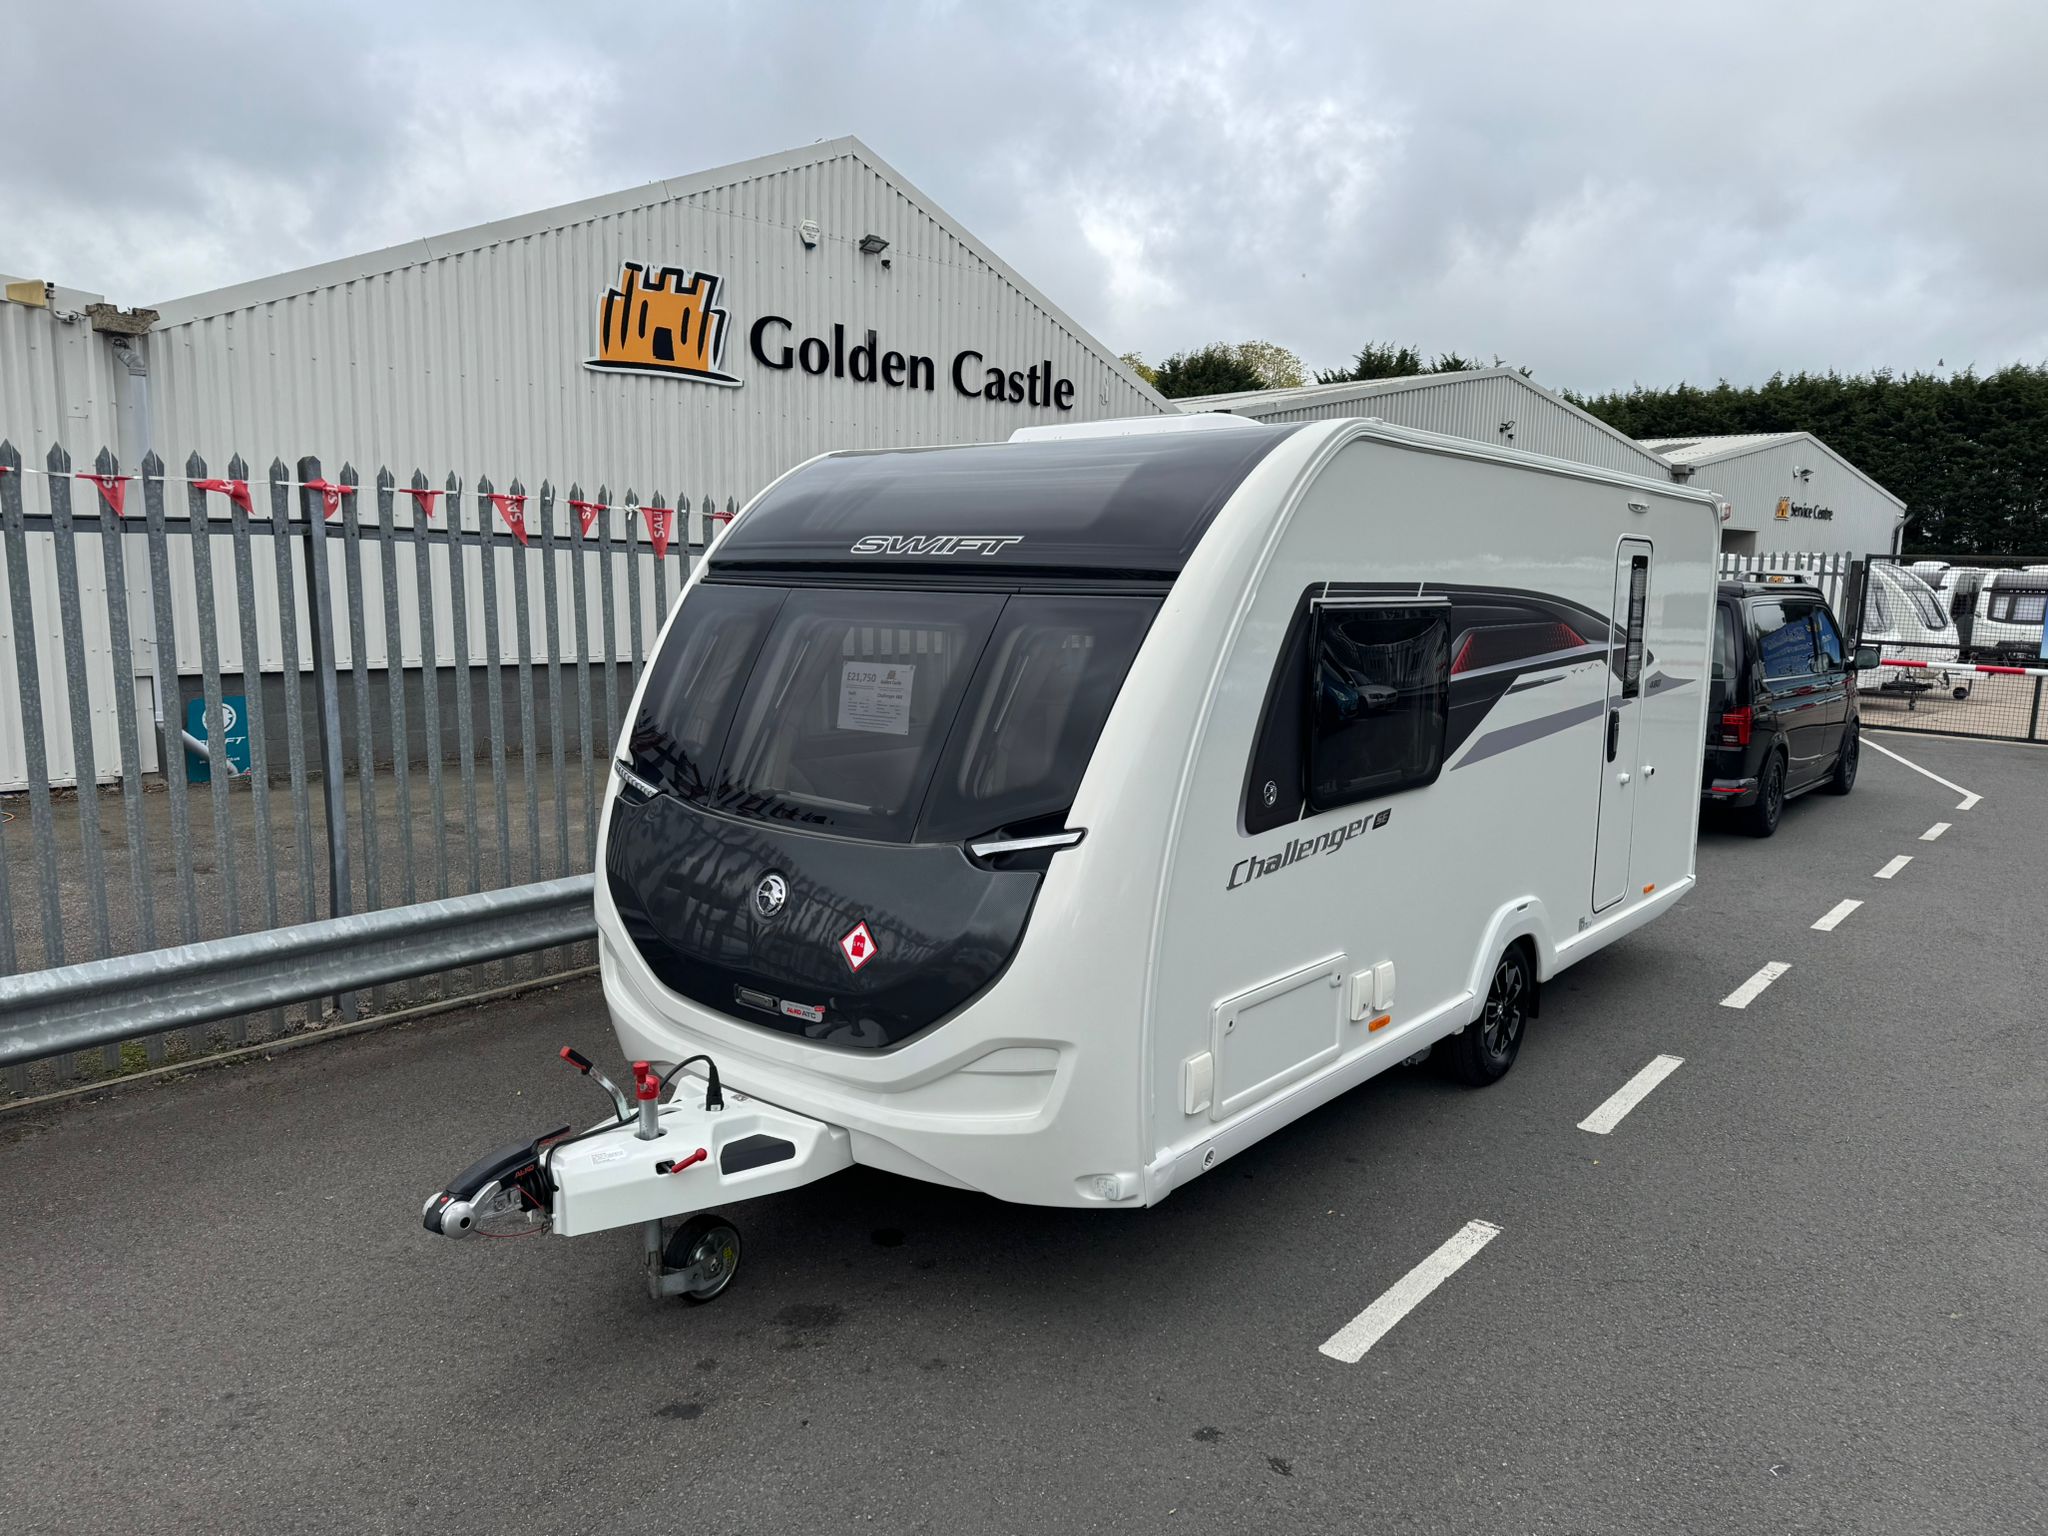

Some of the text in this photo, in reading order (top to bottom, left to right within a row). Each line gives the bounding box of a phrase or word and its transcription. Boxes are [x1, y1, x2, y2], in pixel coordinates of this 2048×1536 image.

[750, 315, 1075, 410] Golden Castle
[1791, 502, 1833, 521] Service Centre
[850, 535, 1025, 555] SWIFT
[1225, 813, 1374, 892] Challenger
